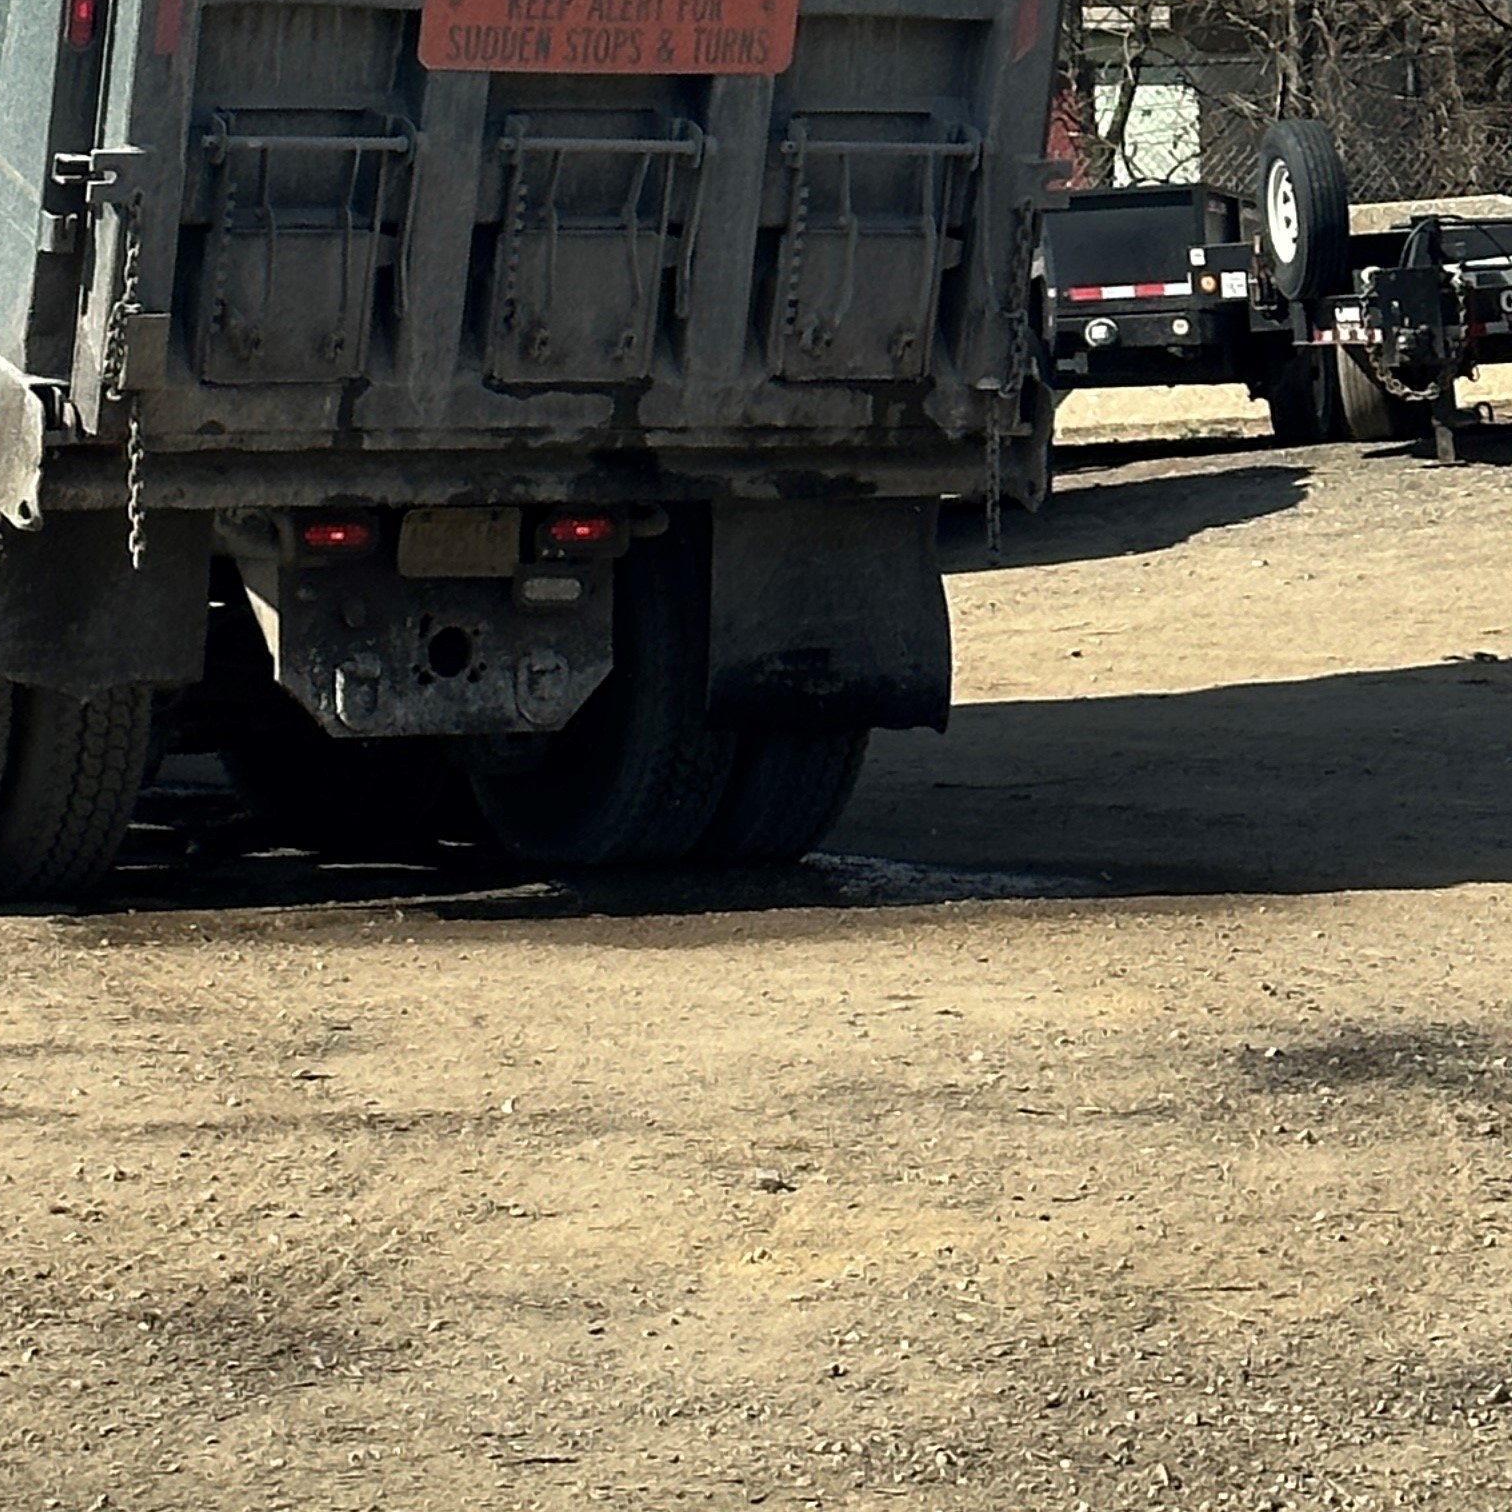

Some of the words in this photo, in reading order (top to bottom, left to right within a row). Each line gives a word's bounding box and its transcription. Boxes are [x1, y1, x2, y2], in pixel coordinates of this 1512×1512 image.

[446, 24, 552, 62] SUDDEN
[565, 28, 645, 64] STOPS
[656, 28, 675, 63] &
[693, 28, 771, 65] TURNS
